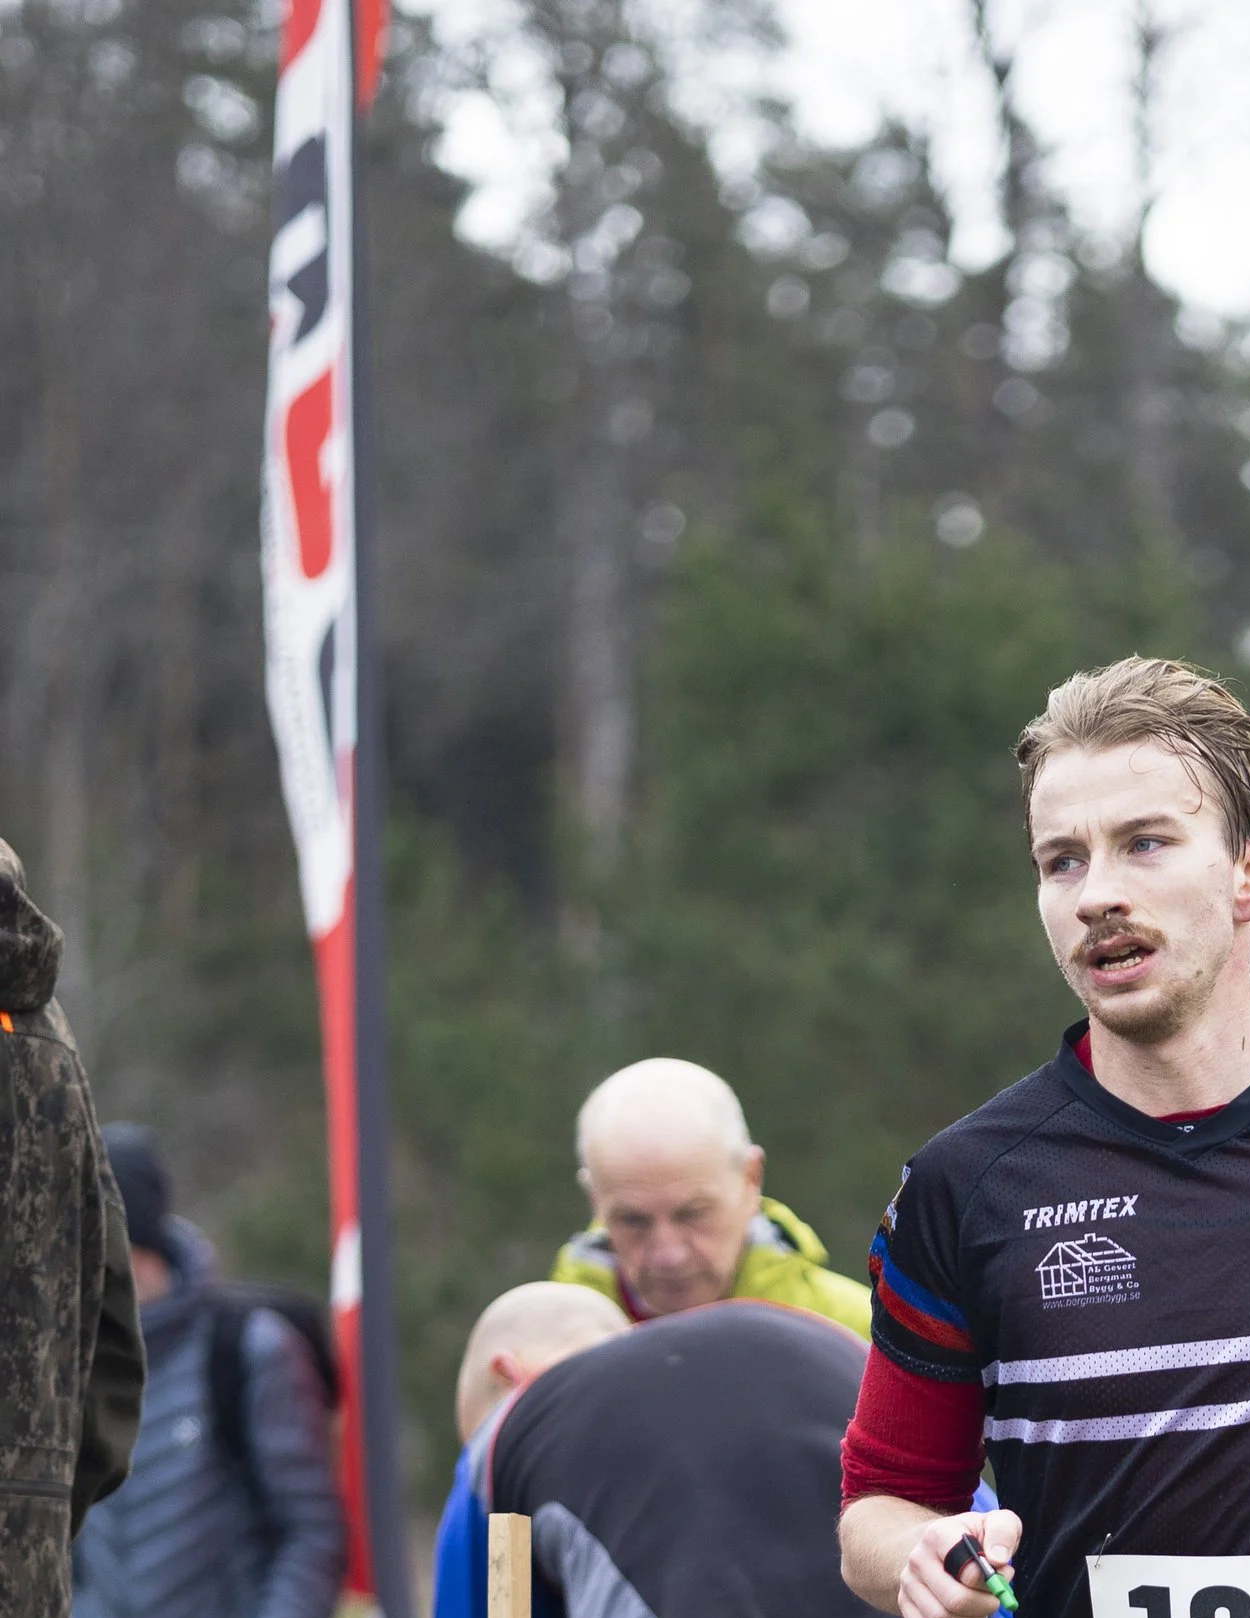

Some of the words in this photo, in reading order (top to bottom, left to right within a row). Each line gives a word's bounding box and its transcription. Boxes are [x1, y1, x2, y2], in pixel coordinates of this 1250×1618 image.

[1023, 1194, 1139, 1231] TRIMTEX
[1088, 1272, 1133, 1283] Bergman
[1089, 1284, 1114, 1294] Bygg
[1116, 1282, 1123, 1290] &
[1126, 1281, 1140, 1289] Co
